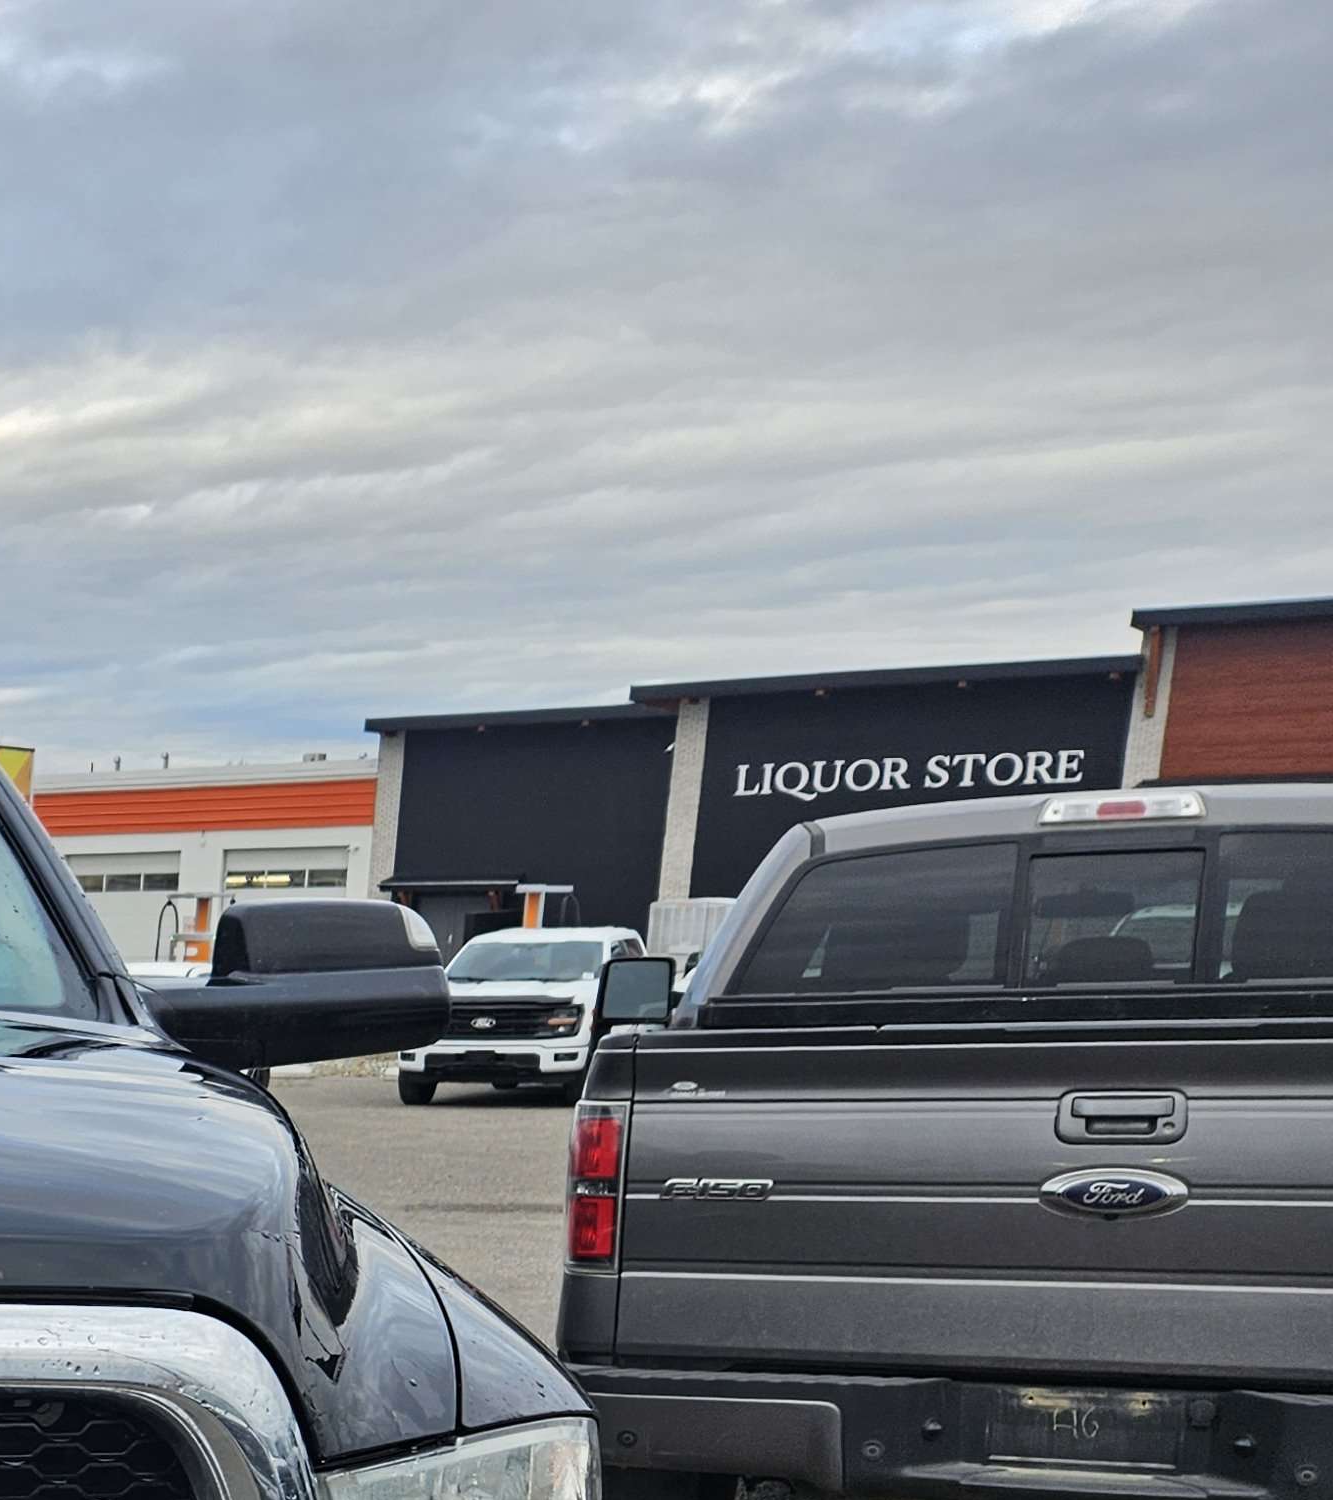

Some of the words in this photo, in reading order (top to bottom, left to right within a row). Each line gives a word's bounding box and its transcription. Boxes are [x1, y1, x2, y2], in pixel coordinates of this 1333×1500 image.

[733, 757, 911, 801] LIQUOR
[923, 749, 1084, 788] STORE
[660, 1178, 773, 1200] F-150
[1084, 1181, 1145, 1204] Ford
